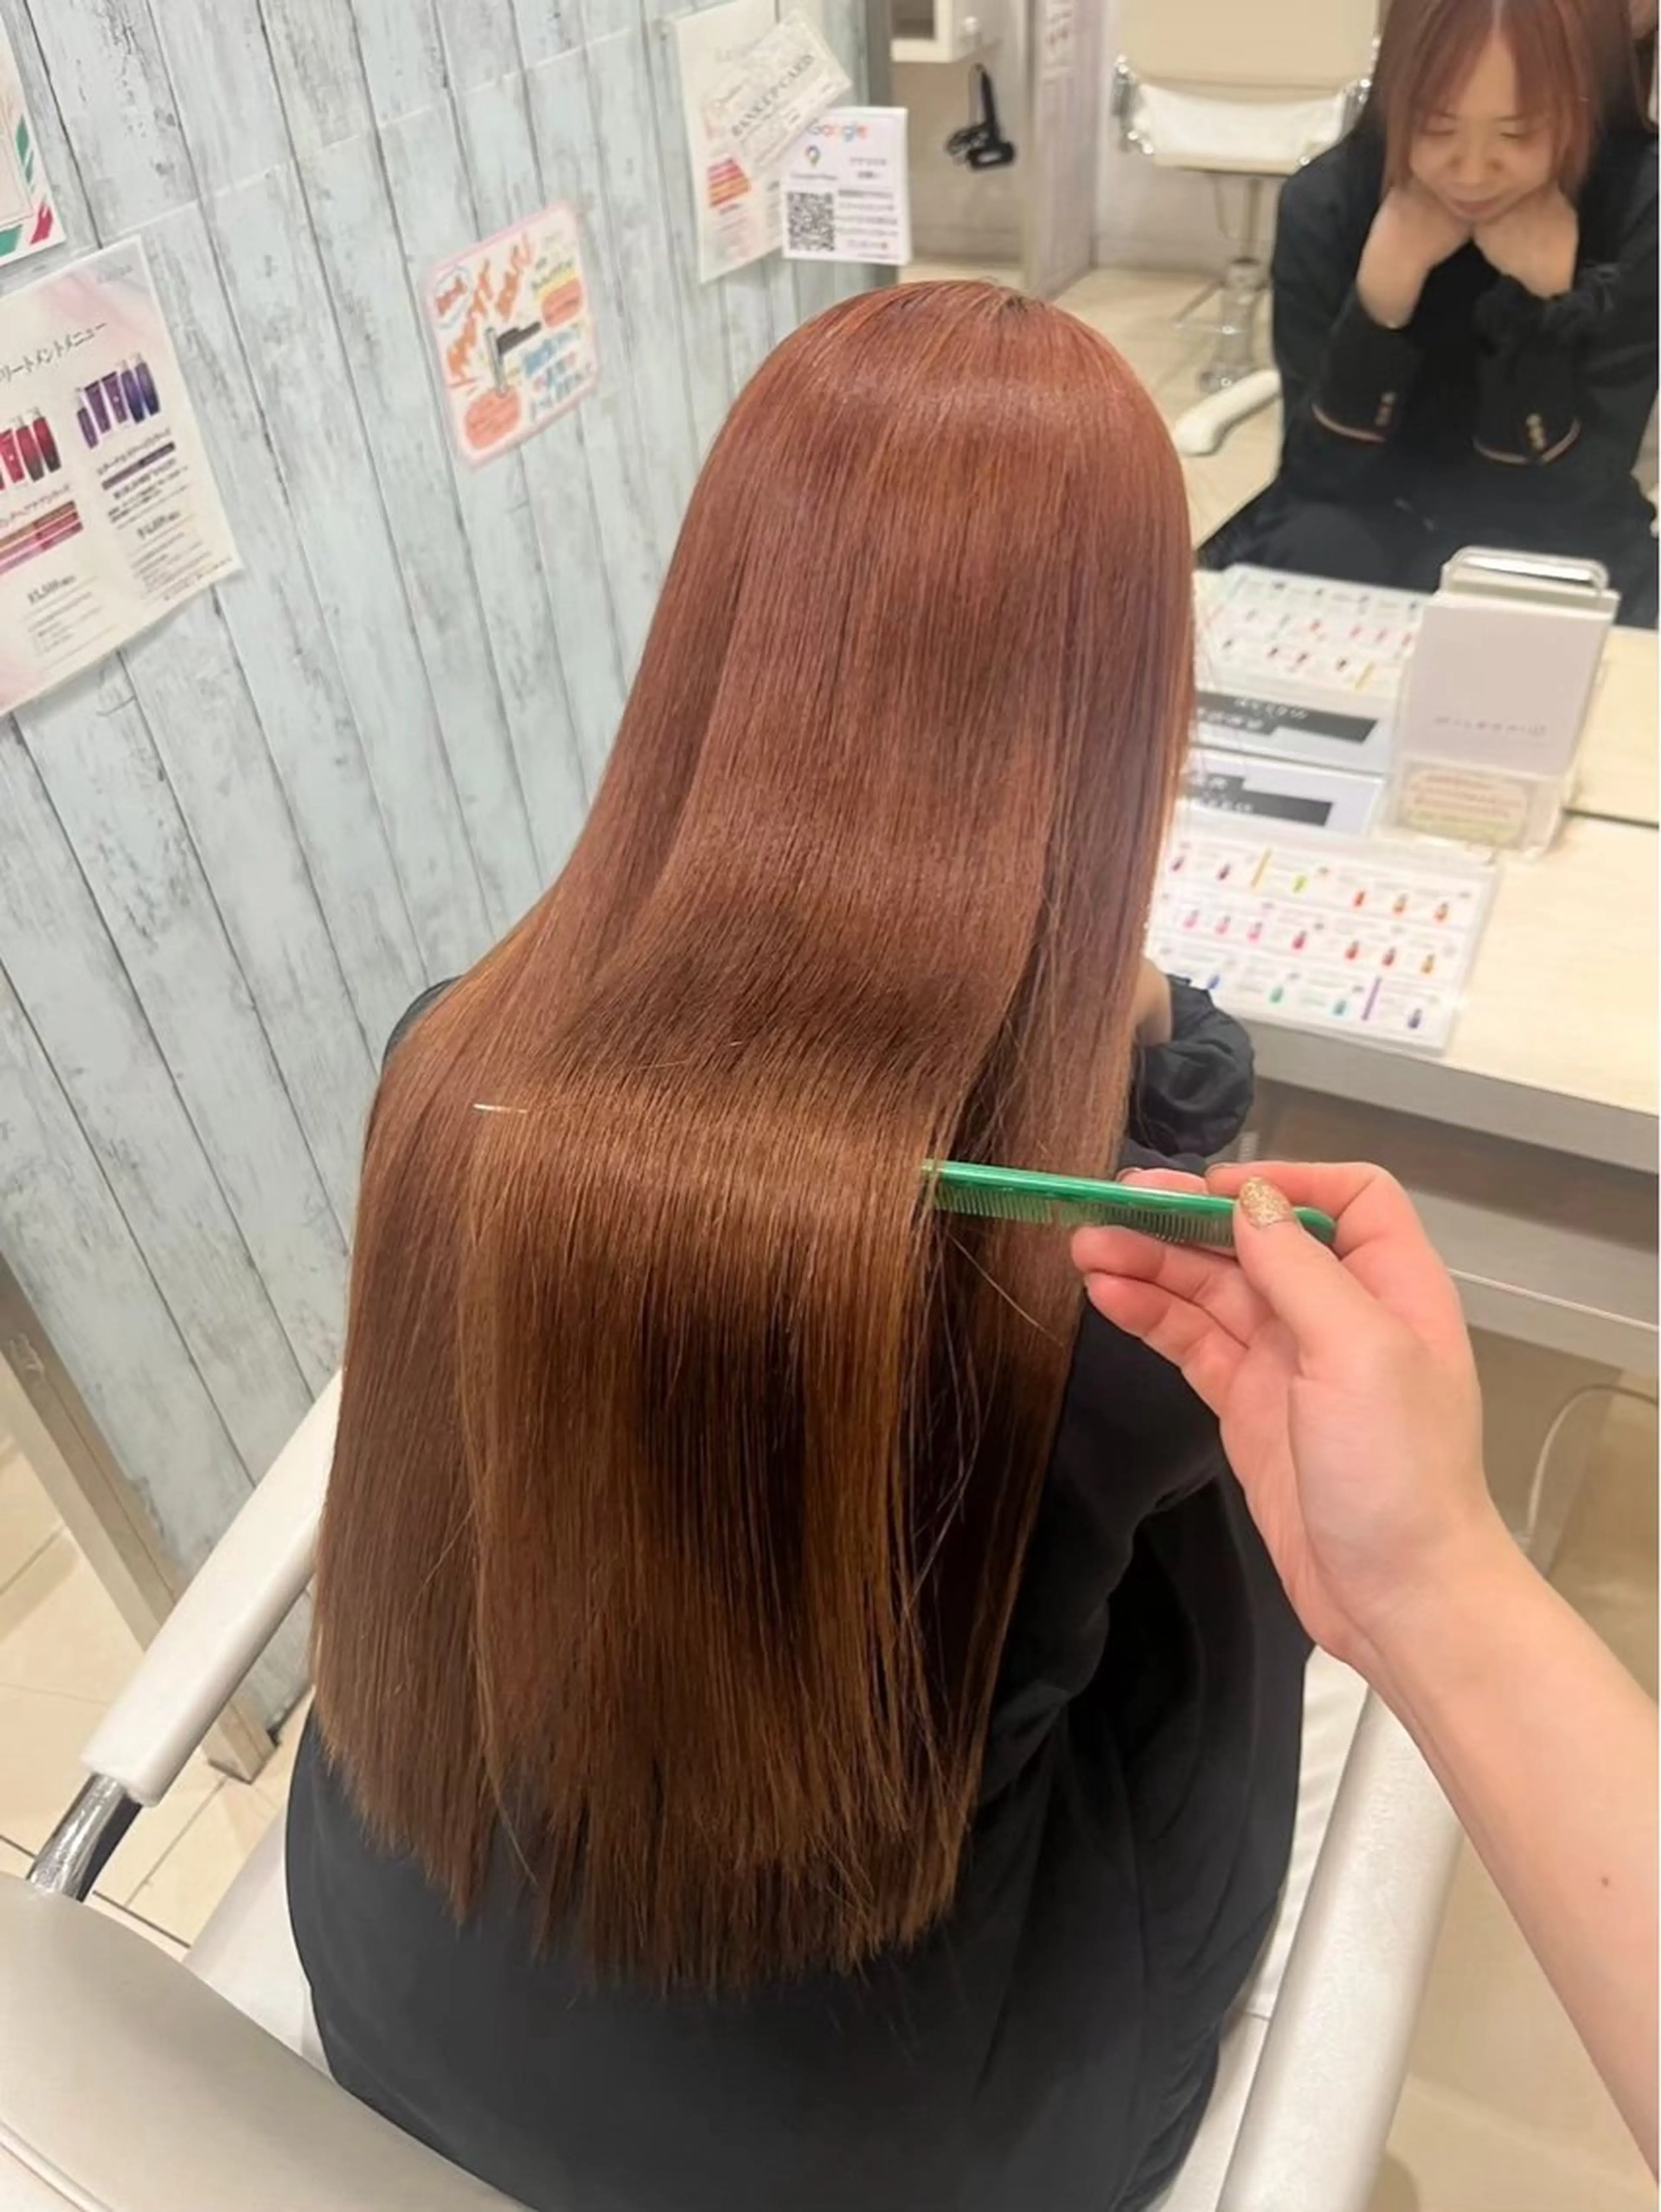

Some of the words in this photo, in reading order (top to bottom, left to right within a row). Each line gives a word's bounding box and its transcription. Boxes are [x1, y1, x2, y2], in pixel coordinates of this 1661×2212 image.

[0, 323, 107, 382] リートメントメニュー
